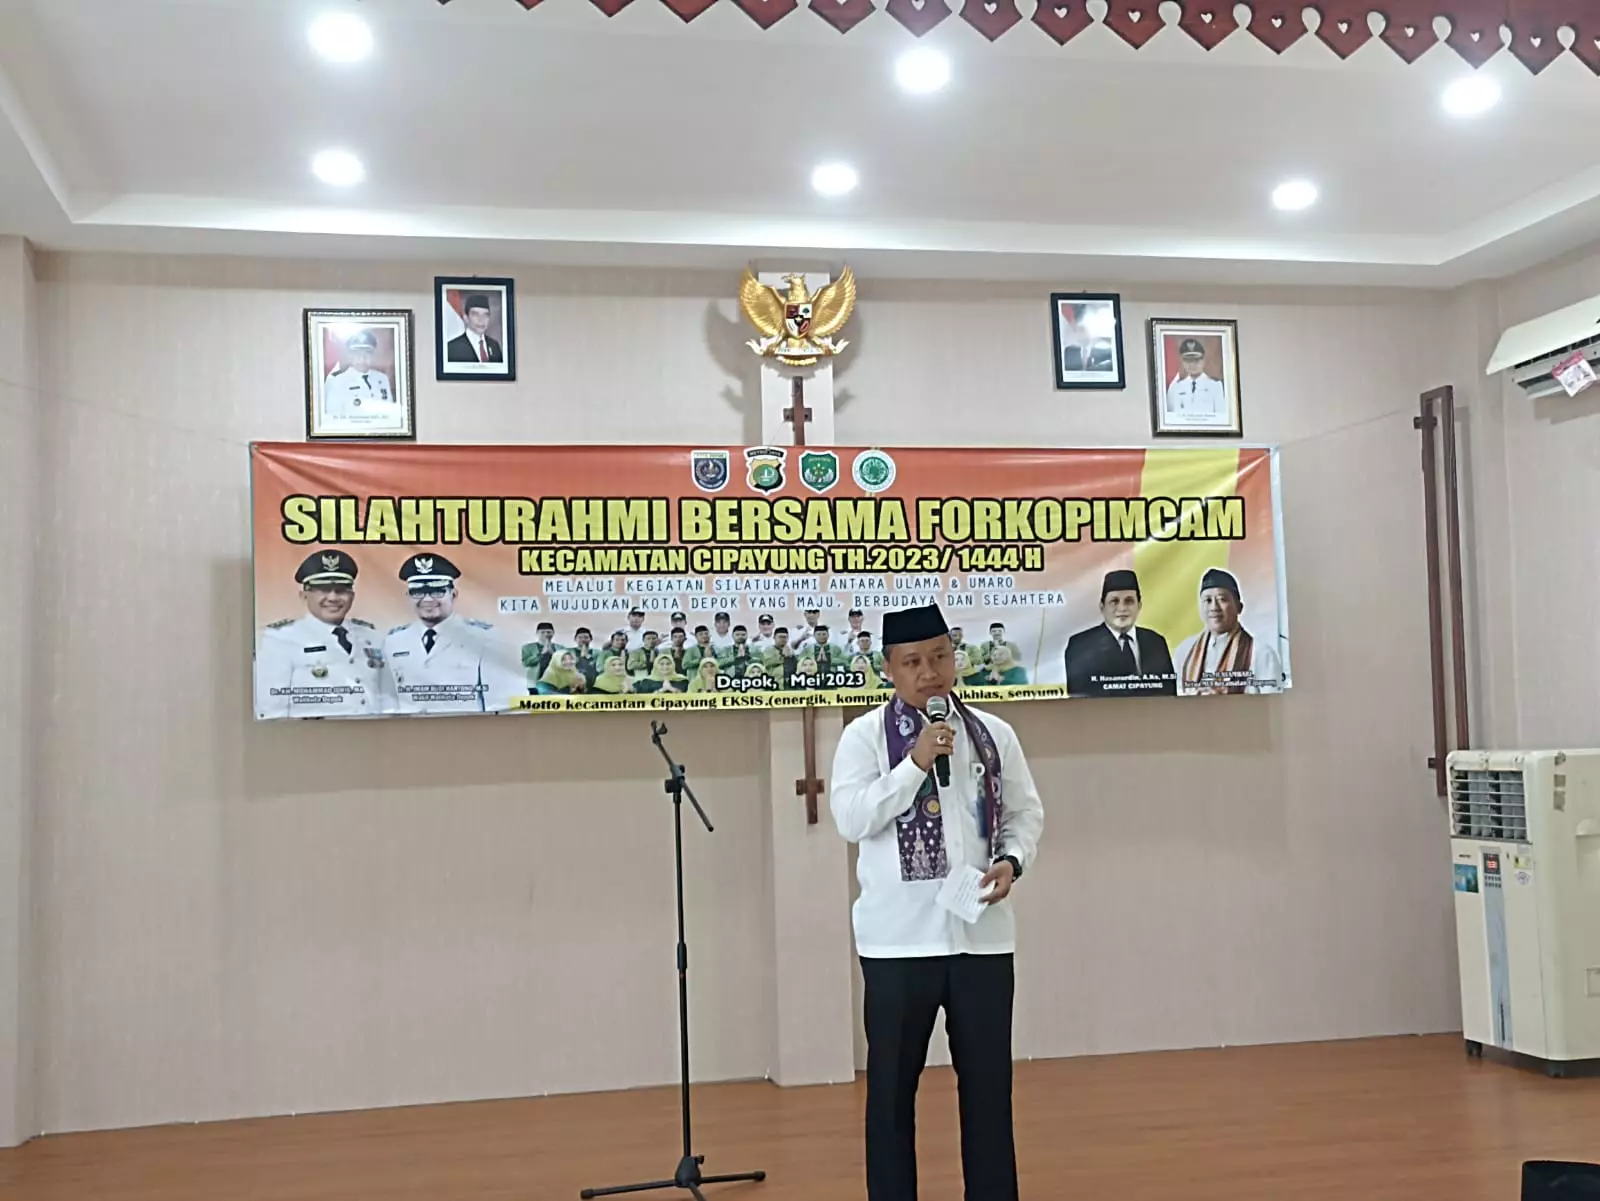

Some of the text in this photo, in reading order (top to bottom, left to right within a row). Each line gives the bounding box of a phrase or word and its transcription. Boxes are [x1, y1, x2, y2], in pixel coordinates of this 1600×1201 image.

[282, 496, 1245, 543] SILAHTURAHMI BERSAMA FORKOPIMCAM
[520, 548, 687, 573] KECAMATAN
[692, 547, 826, 572] CIPAYUNG
[1024, 546, 1043, 570] H
[545, 576, 1014, 592] MELALUI KEGIATAN SILATURAHMI ANTARA ULAMA & UMARO
[500, 599, 539, 611] KITA
[550, 598, 630, 611] WUJUDKAN
[641, 597, 680, 610] KOTA
[691, 597, 738, 609] DEPOK
[749, 596, 786, 609] YANG
[854, 594, 936, 608] BERBUDAYA
[947, 594, 974, 606] DAN
[983, 593, 1064, 606] SEJAHTERA
[716, 672, 865, 692] Depok, Mei'2023
[519, 699, 561, 710] Motto
[566, 698, 646, 710] kecamatan
[650, 697, 717, 711] Cipayung
[959, 689, 1004, 700] ikhlas,
[1007, 687, 1065, 699] senyum)
